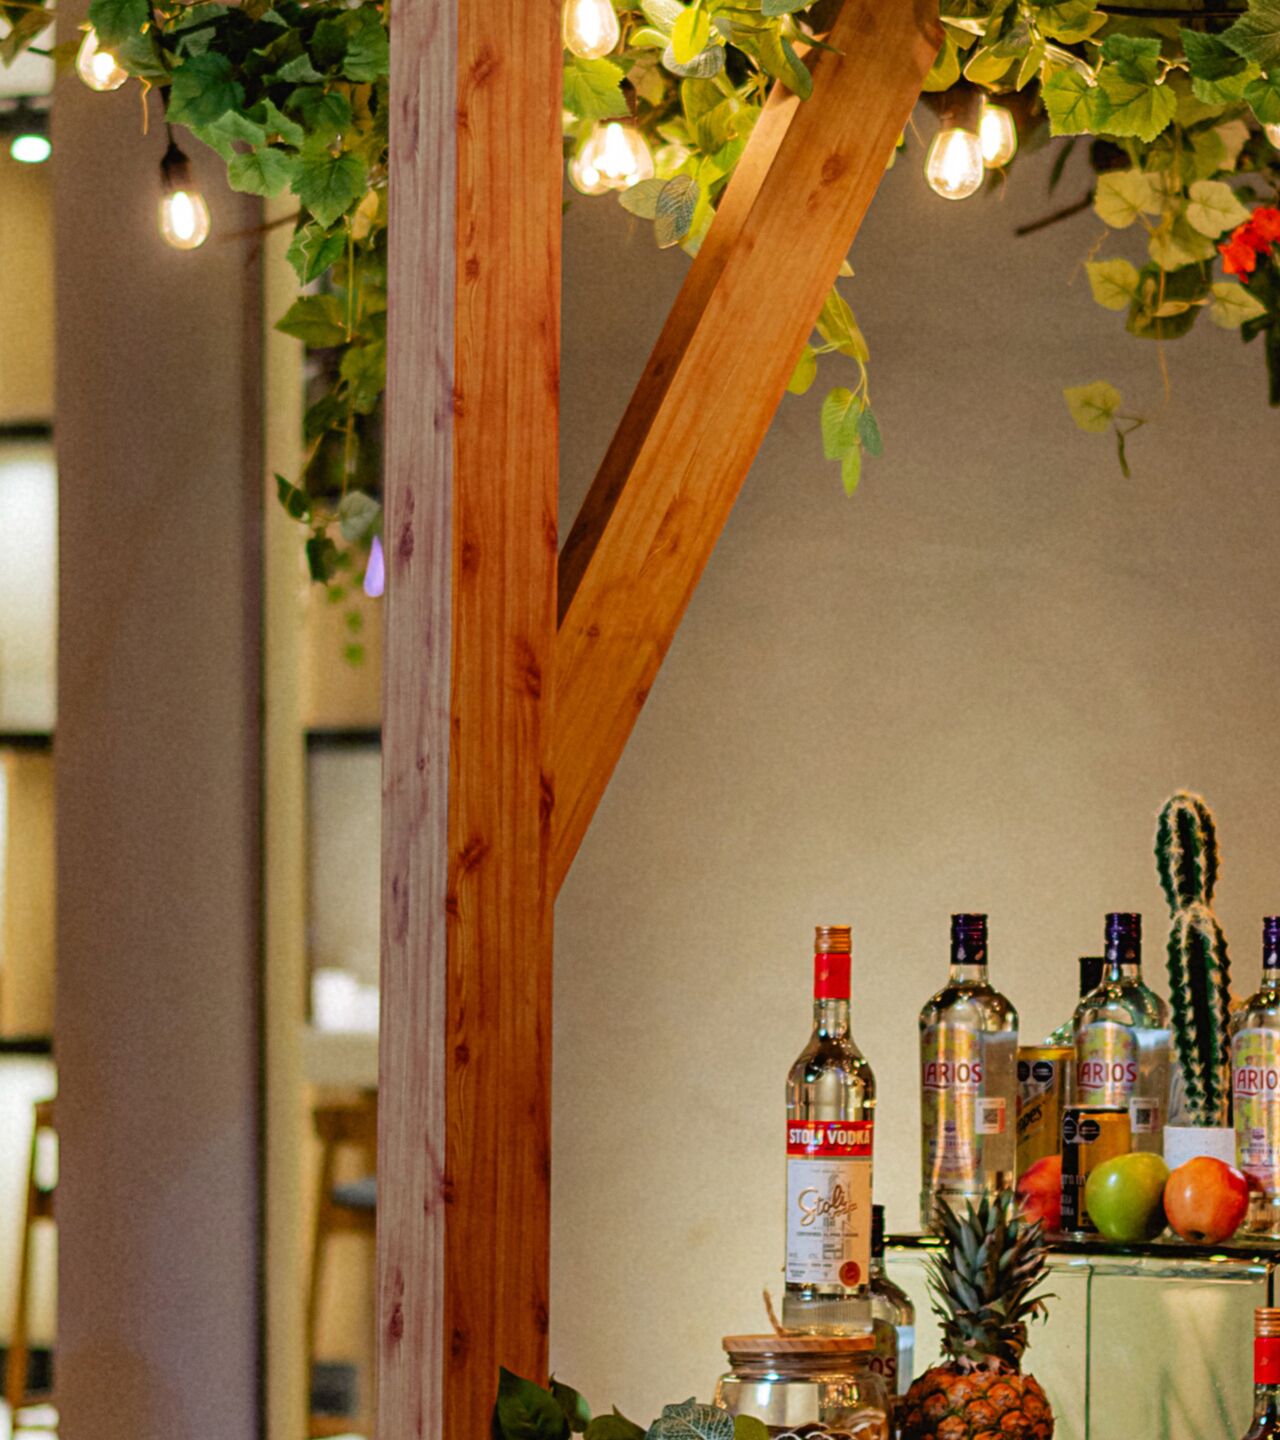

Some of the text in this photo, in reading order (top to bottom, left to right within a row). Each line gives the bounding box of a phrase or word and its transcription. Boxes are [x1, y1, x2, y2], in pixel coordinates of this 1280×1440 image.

[1076, 1062, 1137, 1089] LARIOS
[827, 1130, 870, 1145] VODKA
[798, 1184, 847, 1227] Stoli
